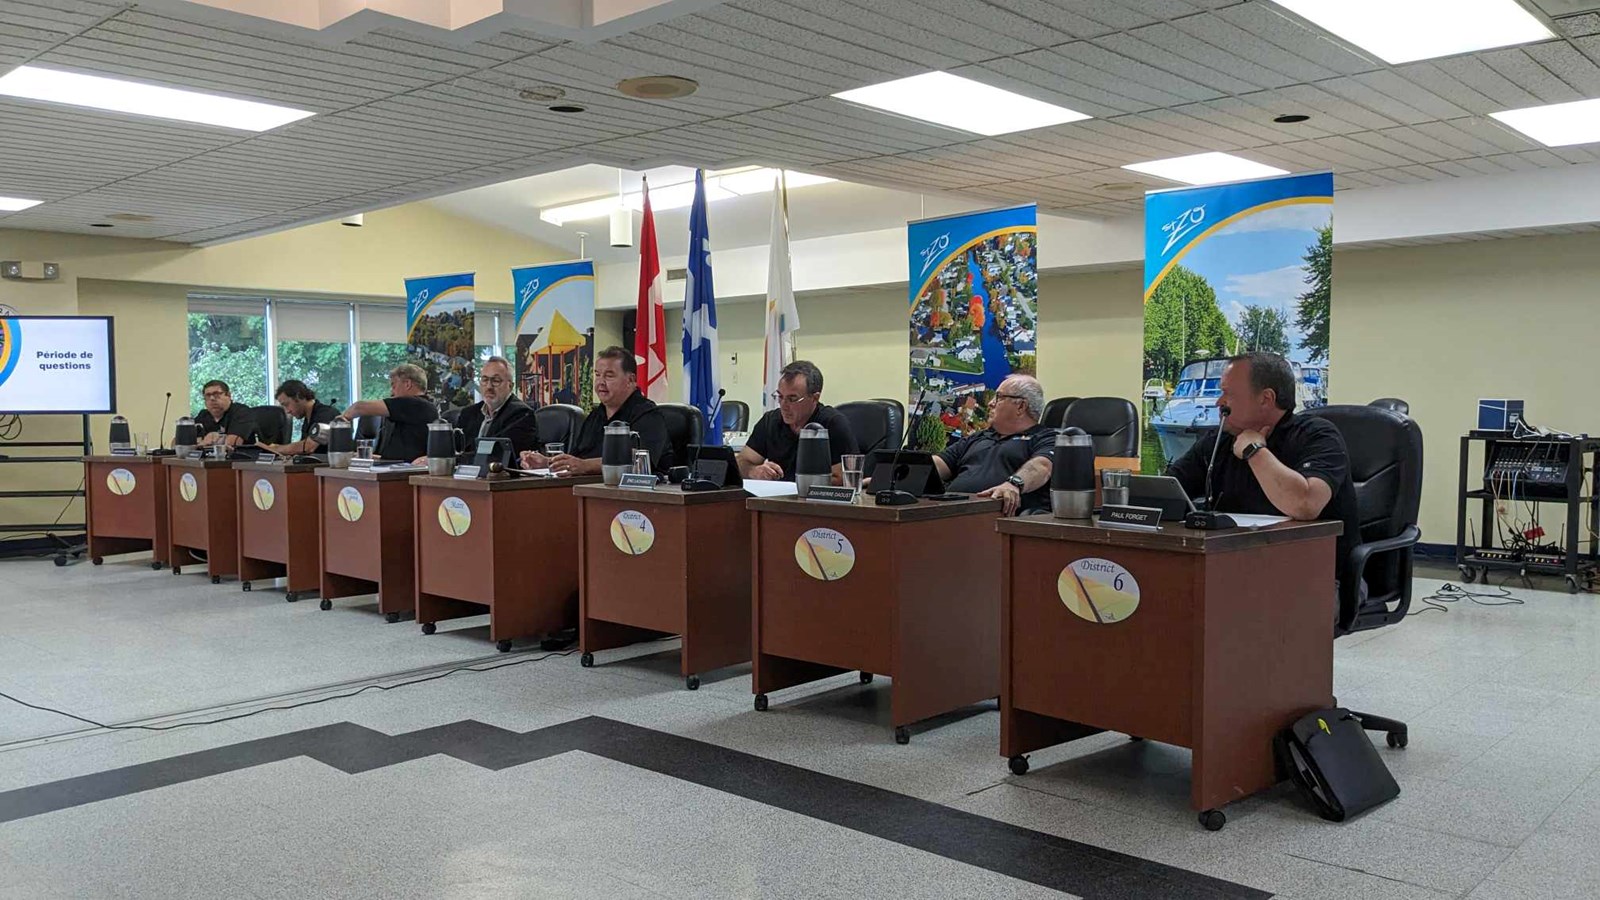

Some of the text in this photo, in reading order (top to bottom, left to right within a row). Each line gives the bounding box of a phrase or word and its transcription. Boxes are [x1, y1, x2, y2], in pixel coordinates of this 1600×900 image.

[36, 350, 93, 359] Période de
[39, 361, 92, 371] questions
[1110, 511, 1149, 521] PAUL FORGET
[639, 519, 647, 532] 4
[812, 529, 837, 540] District
[834, 538, 844, 554] 5
[1081, 560, 1116, 573] District
[1113, 572, 1126, 591] 6
